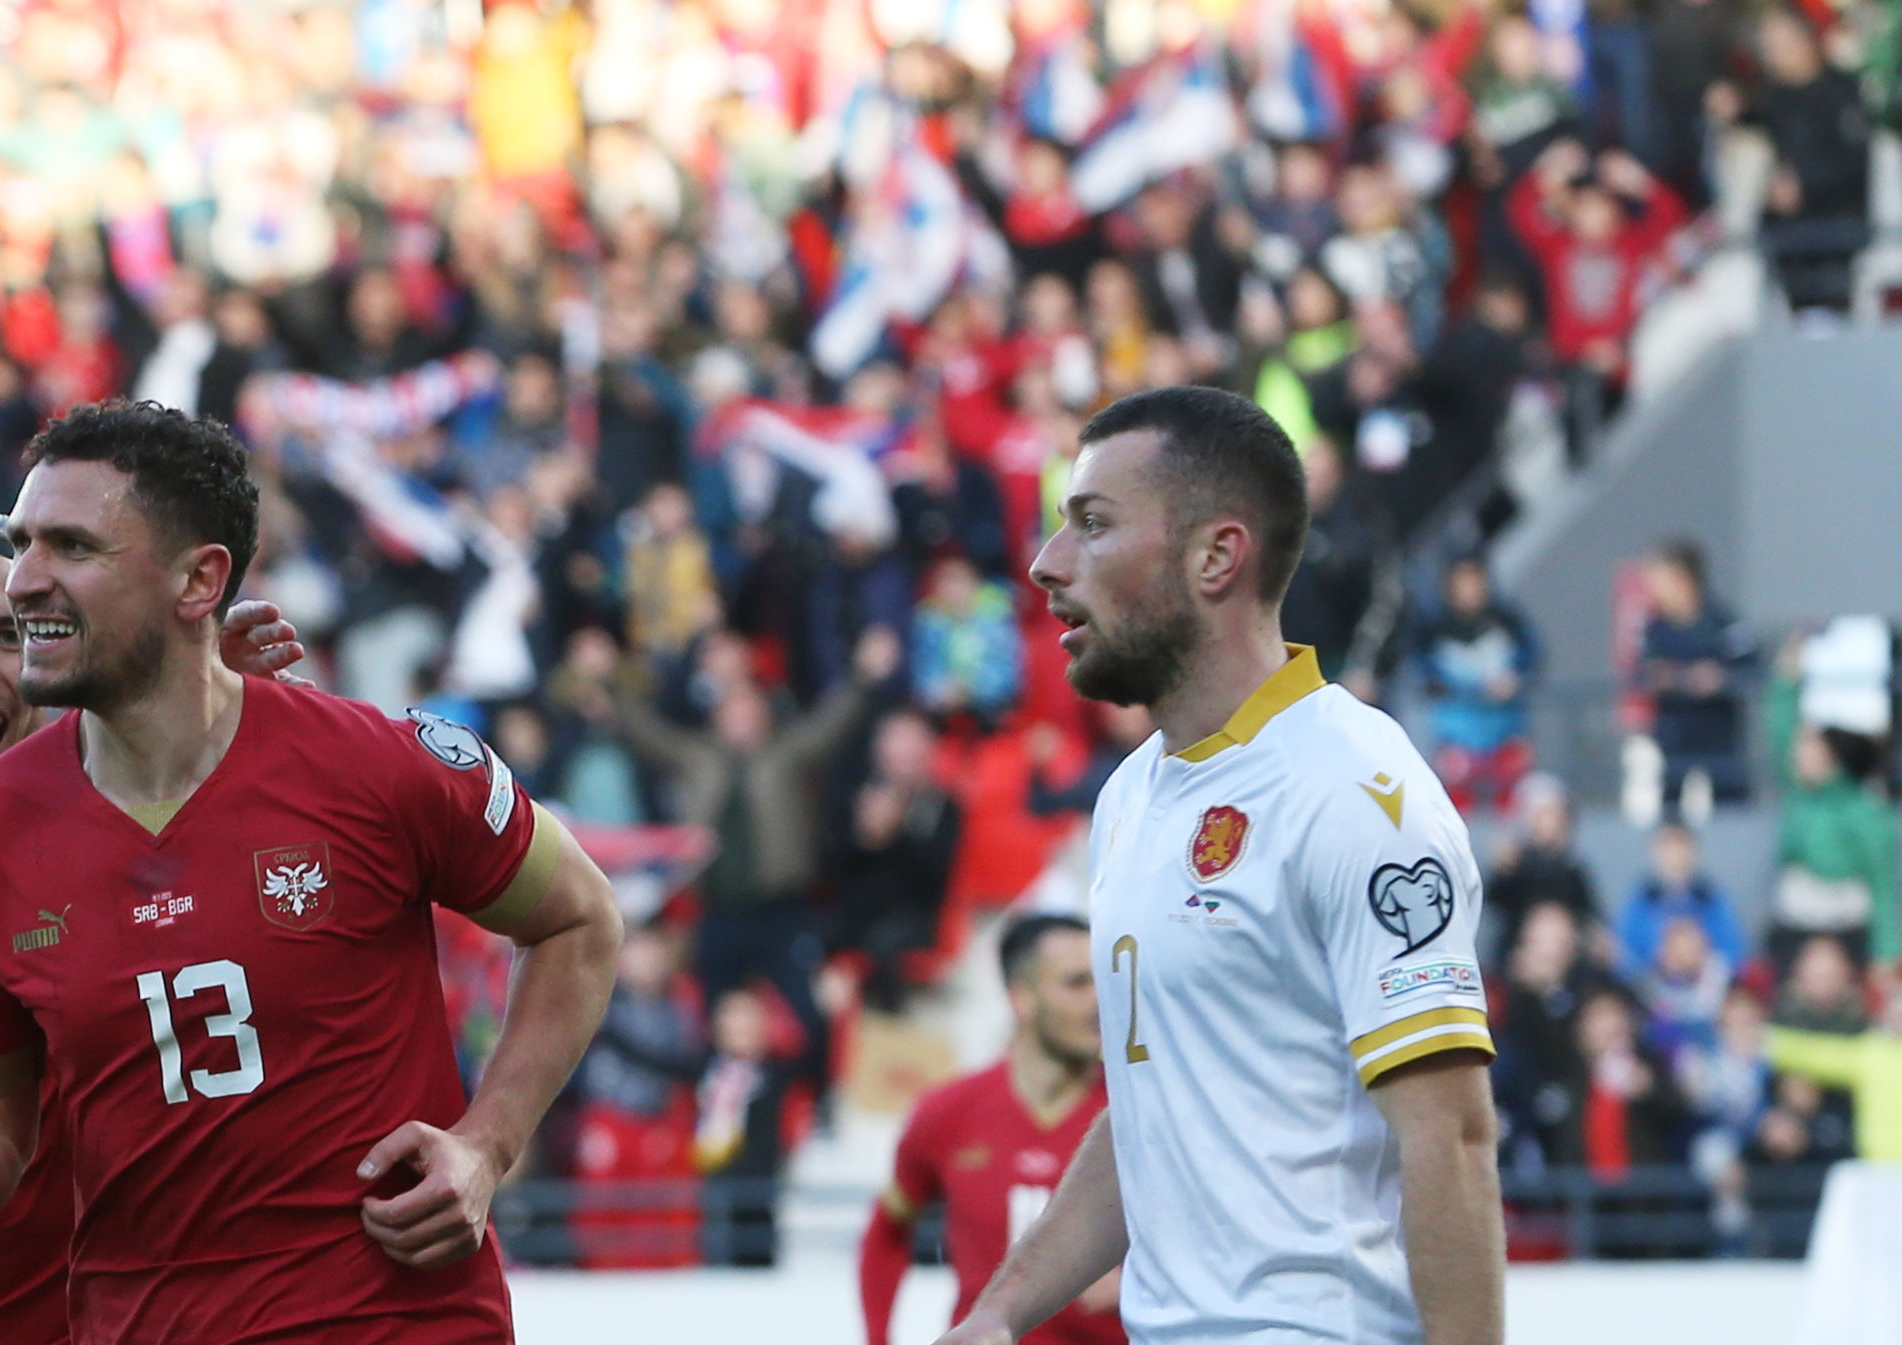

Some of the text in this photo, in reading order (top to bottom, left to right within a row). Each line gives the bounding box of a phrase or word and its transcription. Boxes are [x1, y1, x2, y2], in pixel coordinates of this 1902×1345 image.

[12, 925, 61, 954] PUMA
[133, 903, 159, 924] SRB
[167, 895, 194, 916] BGR
[136, 958, 265, 1105] 13
[1112, 934, 1151, 1064] 2
